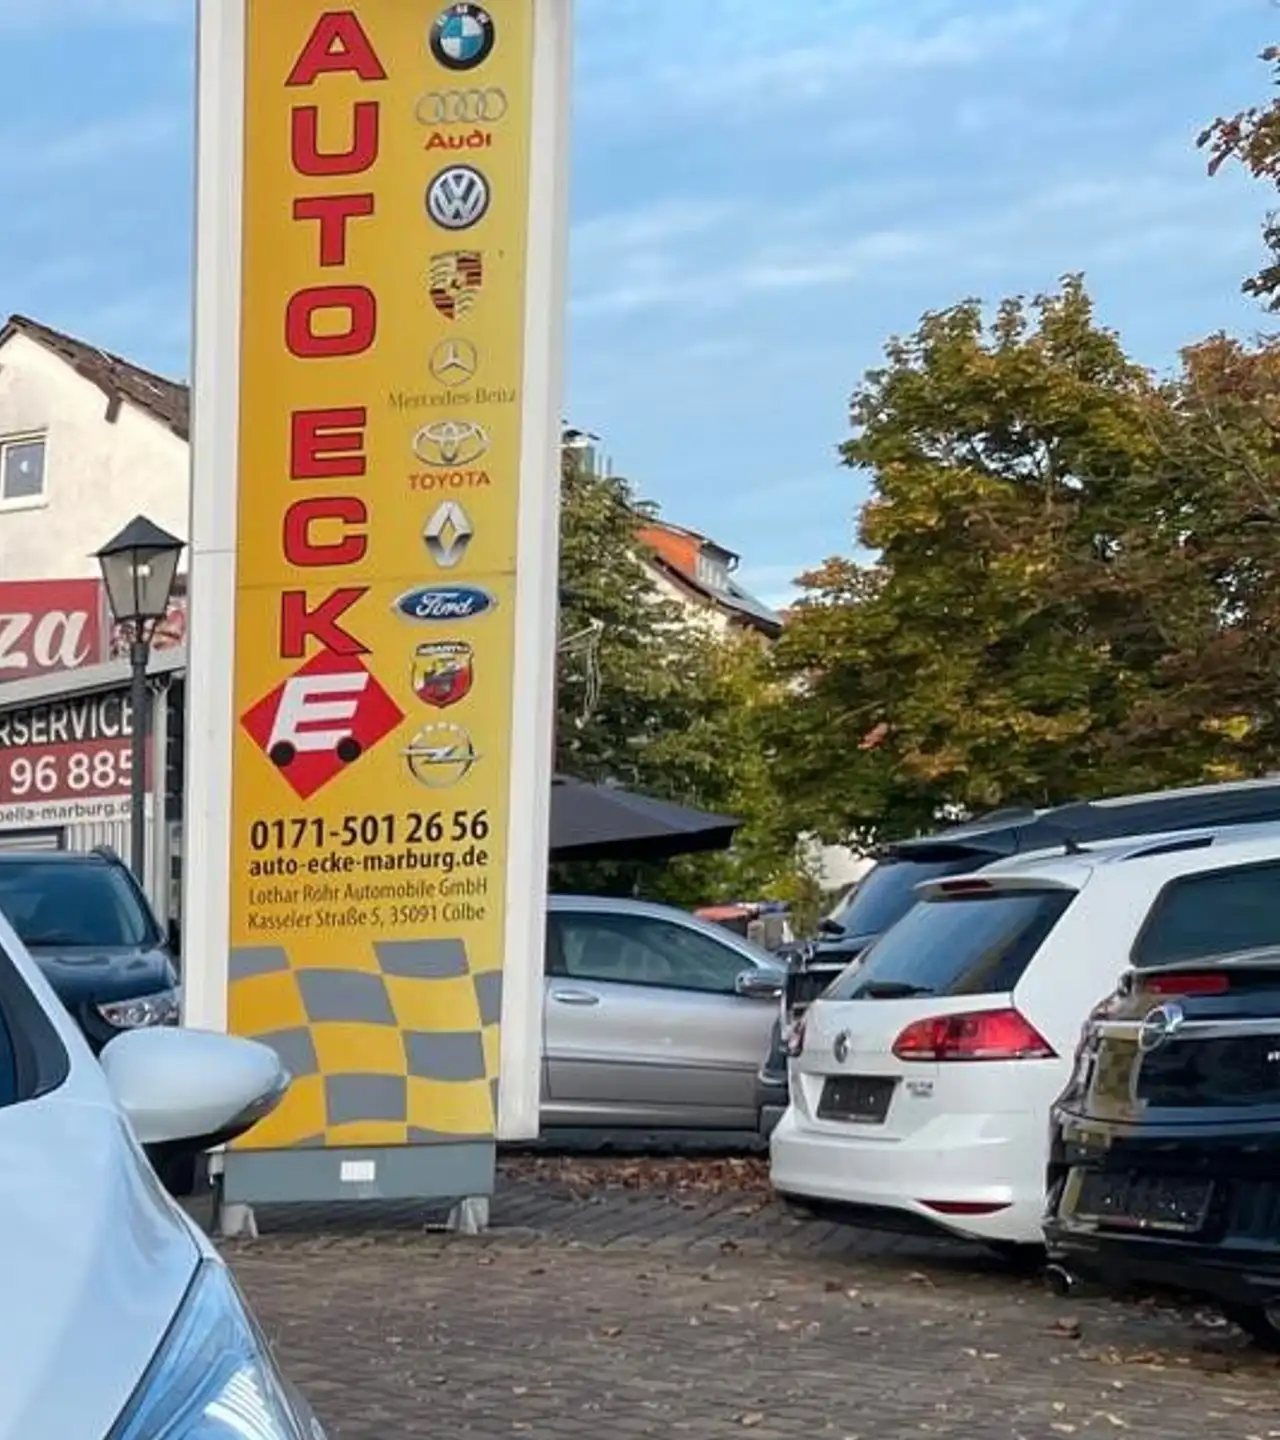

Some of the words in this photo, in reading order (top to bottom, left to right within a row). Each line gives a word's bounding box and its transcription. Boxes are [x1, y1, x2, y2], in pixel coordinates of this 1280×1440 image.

[424, 129, 491, 151] Audi
[284, 11, 388, 359] AUTO
[408, 470, 491, 490] TOYOTA
[416, 592, 473, 616] Ford
[10, 756, 58, 795] 96
[251, 814, 395, 850] 0171-501
[406, 811, 443, 844] 26
[451, 809, 490, 842] 56
[250, 845, 488, 877] auto-ecke-marburg.de
[249, 885, 297, 905] Lothar
[344, 878, 436, 901] Automobile
[440, 876, 488, 898] GmbH
[248, 909, 311, 930] Kasseler
[316, 905, 367, 928] Straße
[391, 903, 438, 925] 35091
